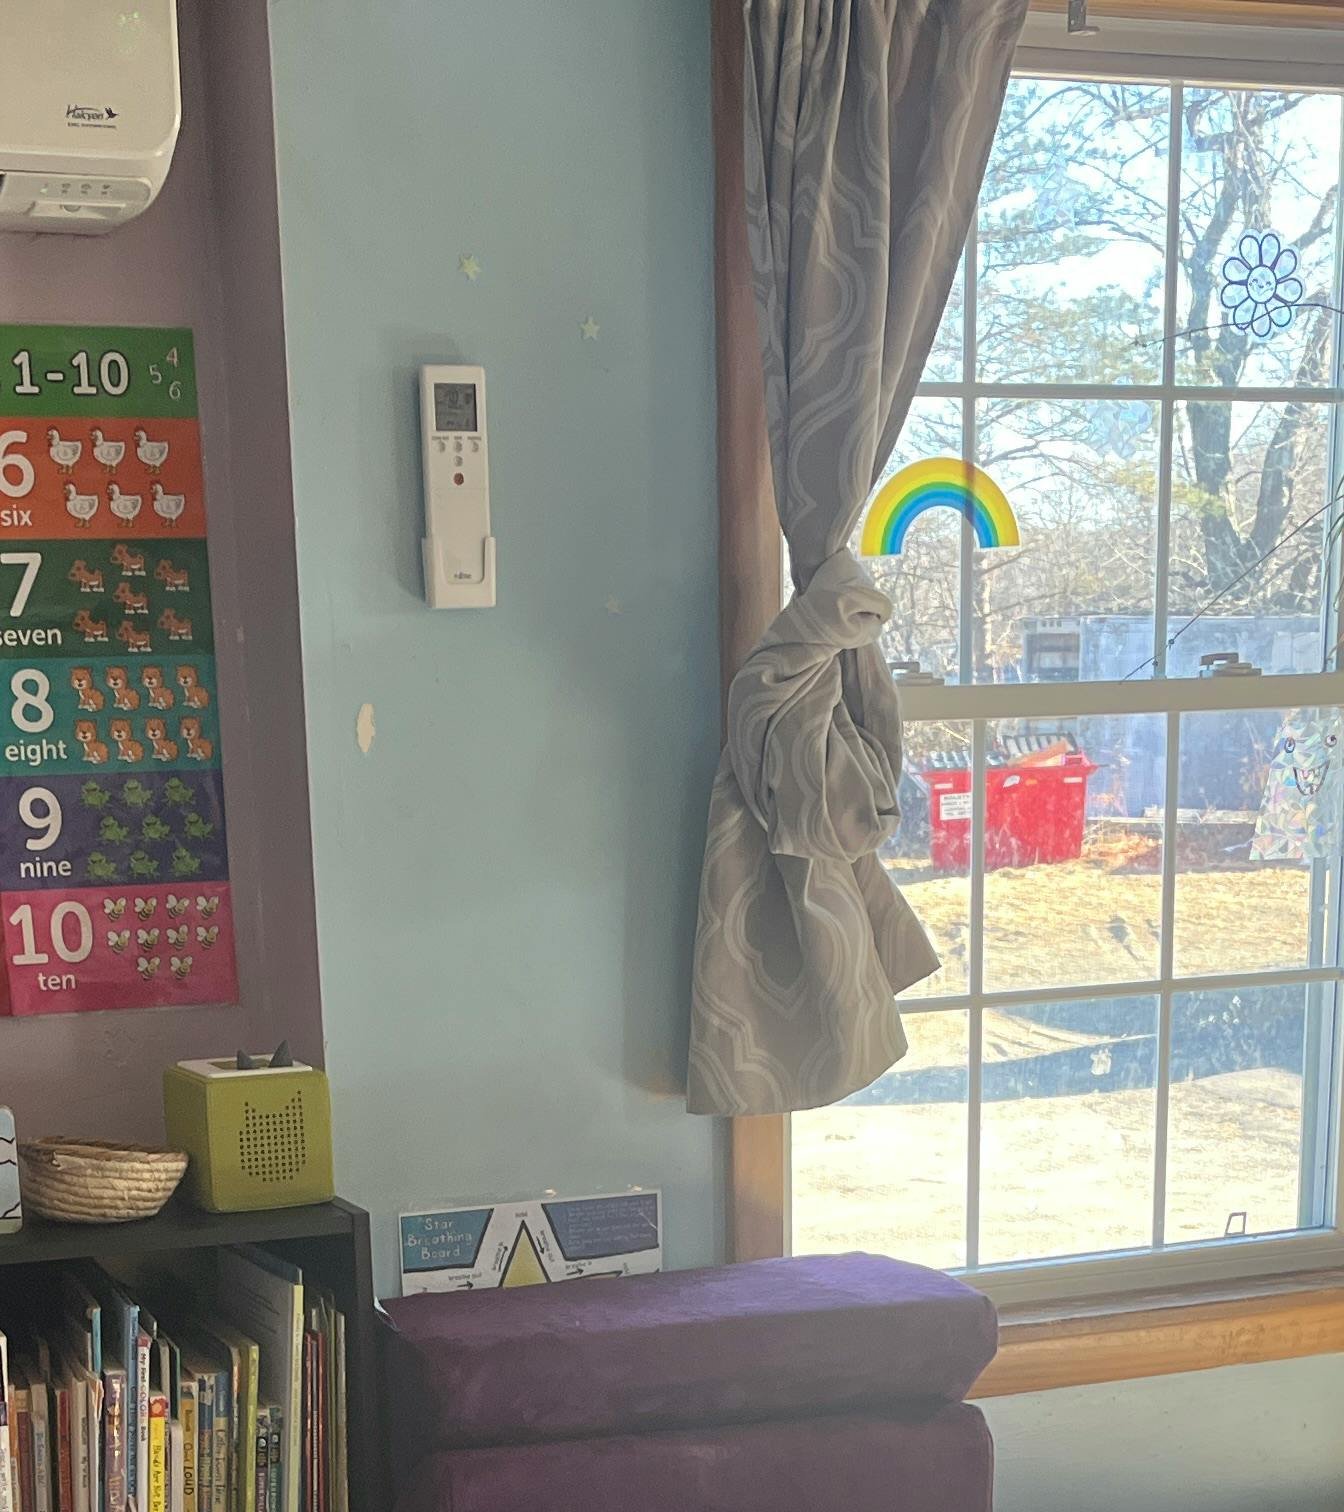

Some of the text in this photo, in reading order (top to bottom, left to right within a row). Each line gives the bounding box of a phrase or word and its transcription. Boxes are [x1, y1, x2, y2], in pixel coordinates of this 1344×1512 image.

[165, 346, 179, 367] 4
[12, 349, 131, 396] 1-10
[149, 364, 162, 385] 5
[168, 381, 181, 400] 6
[0, 504, 32, 528] six
[0, 552, 42, 617] 7
[10, 668, 54, 733] 8
[5, 738, 67, 766] eight
[18, 786, 63, 851] 9
[19, 856, 72, 879] nine
[8, 900, 94, 965] 10
[38, 970, 76, 991] ten
[424, 1217, 453, 1231] Star
[407, 1231, 473, 1248] Breathing
[421, 1247, 461, 1260] Board
[182, 1465, 193, 1495] LOUD
